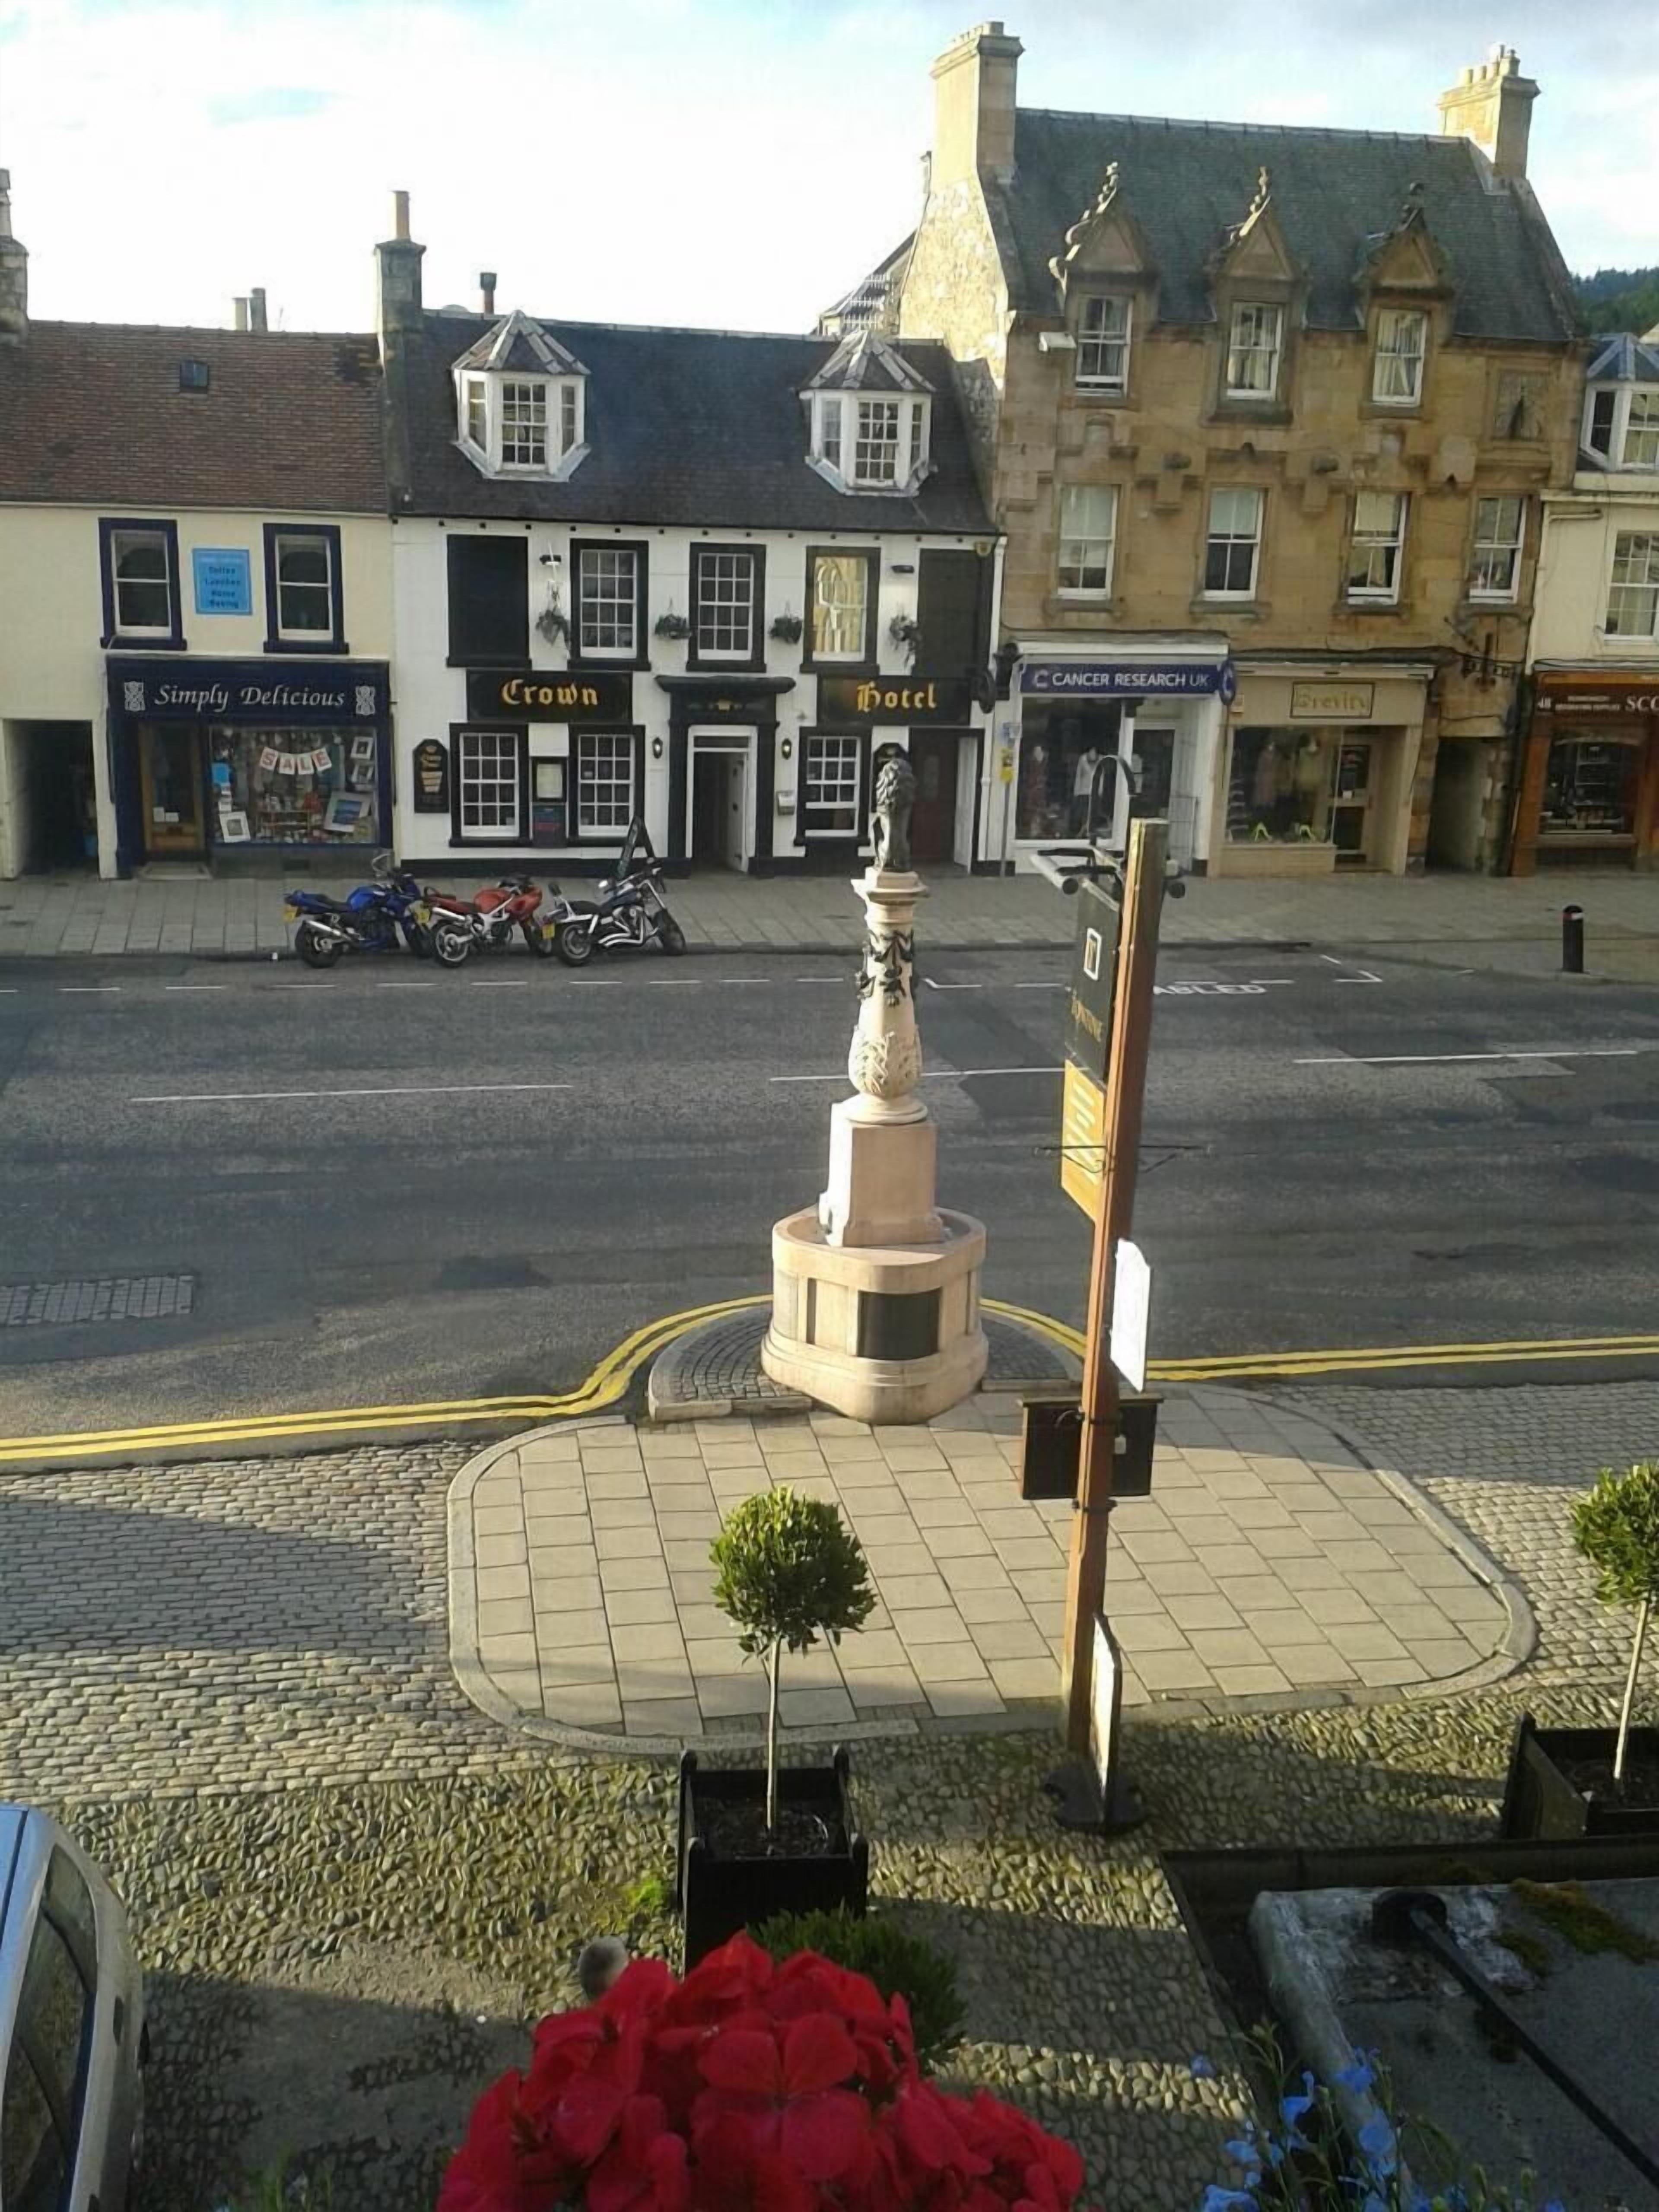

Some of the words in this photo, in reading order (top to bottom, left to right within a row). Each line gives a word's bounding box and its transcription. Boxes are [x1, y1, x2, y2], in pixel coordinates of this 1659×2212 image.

[1052, 672, 1109, 686] CANCER
[1114, 673, 1185, 687] RESEARCH
[1189, 673, 1211, 687] UK
[154, 683, 229, 712] Simply
[239, 684, 345, 706] Delicious
[502, 679, 598, 705] Crown
[857, 680, 937, 712] Hotel
[261, 750, 330, 771] SALE
[1153, 984, 1267, 995] ABLED
